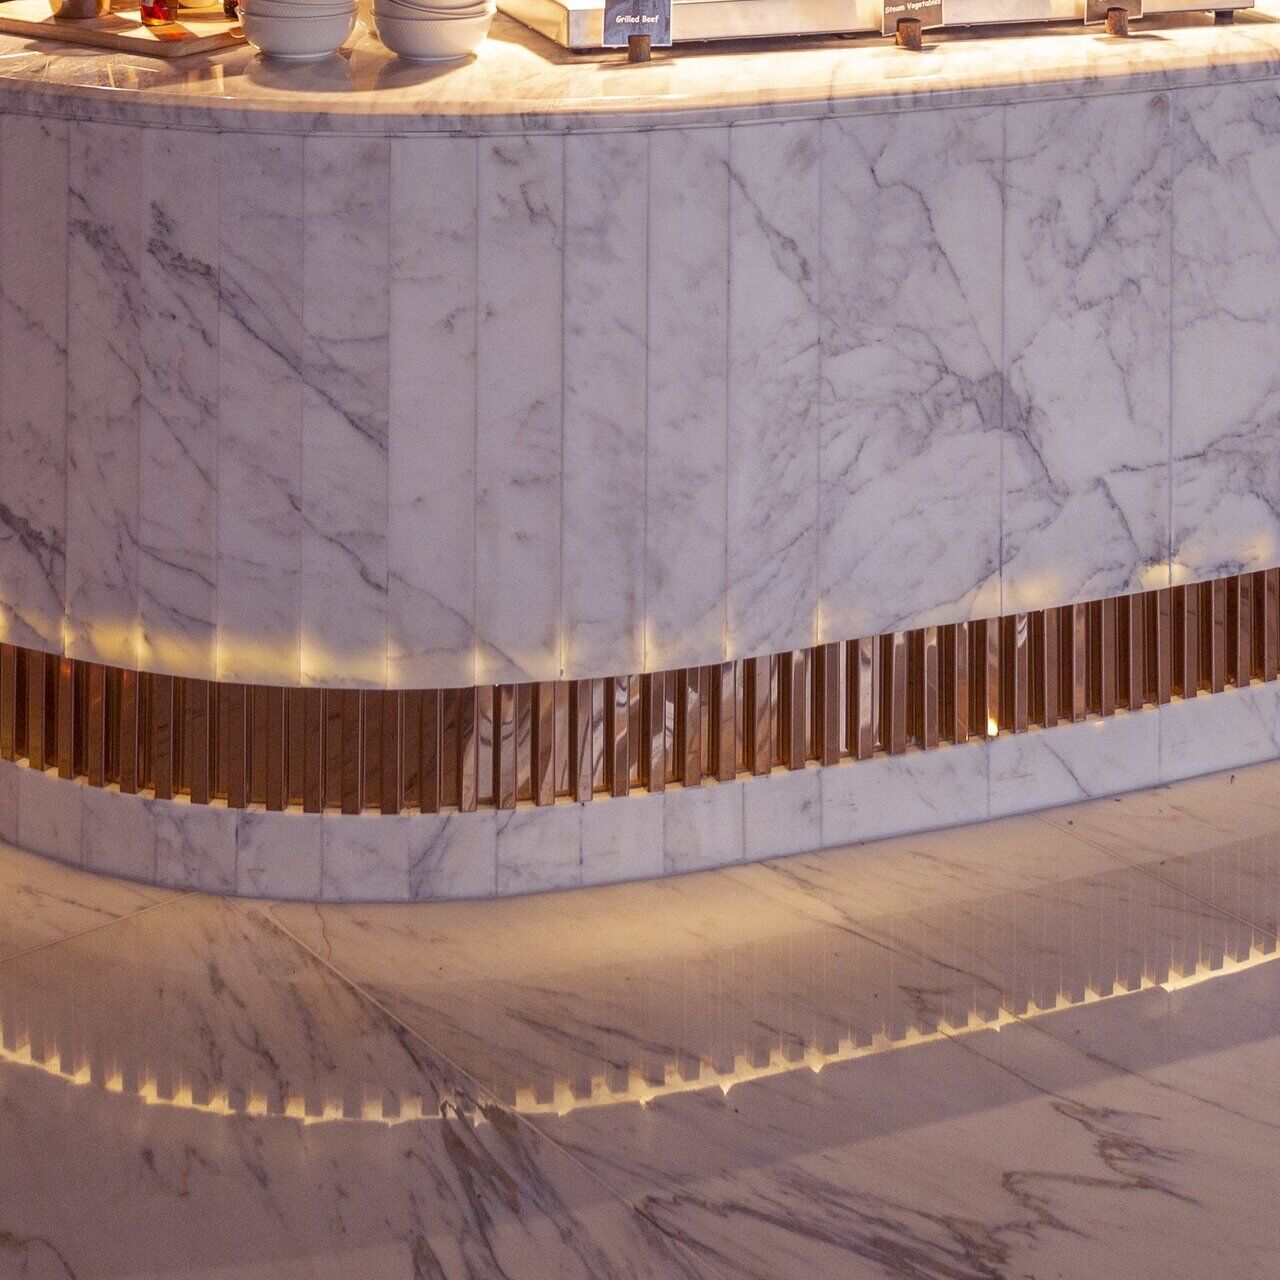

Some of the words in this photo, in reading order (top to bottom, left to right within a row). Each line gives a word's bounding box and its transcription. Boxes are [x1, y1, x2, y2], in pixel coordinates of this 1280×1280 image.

[885, 4, 905, 14] Steam
[616, 15, 640, 23] Grilled
[642, 15, 659, 23] Beef
